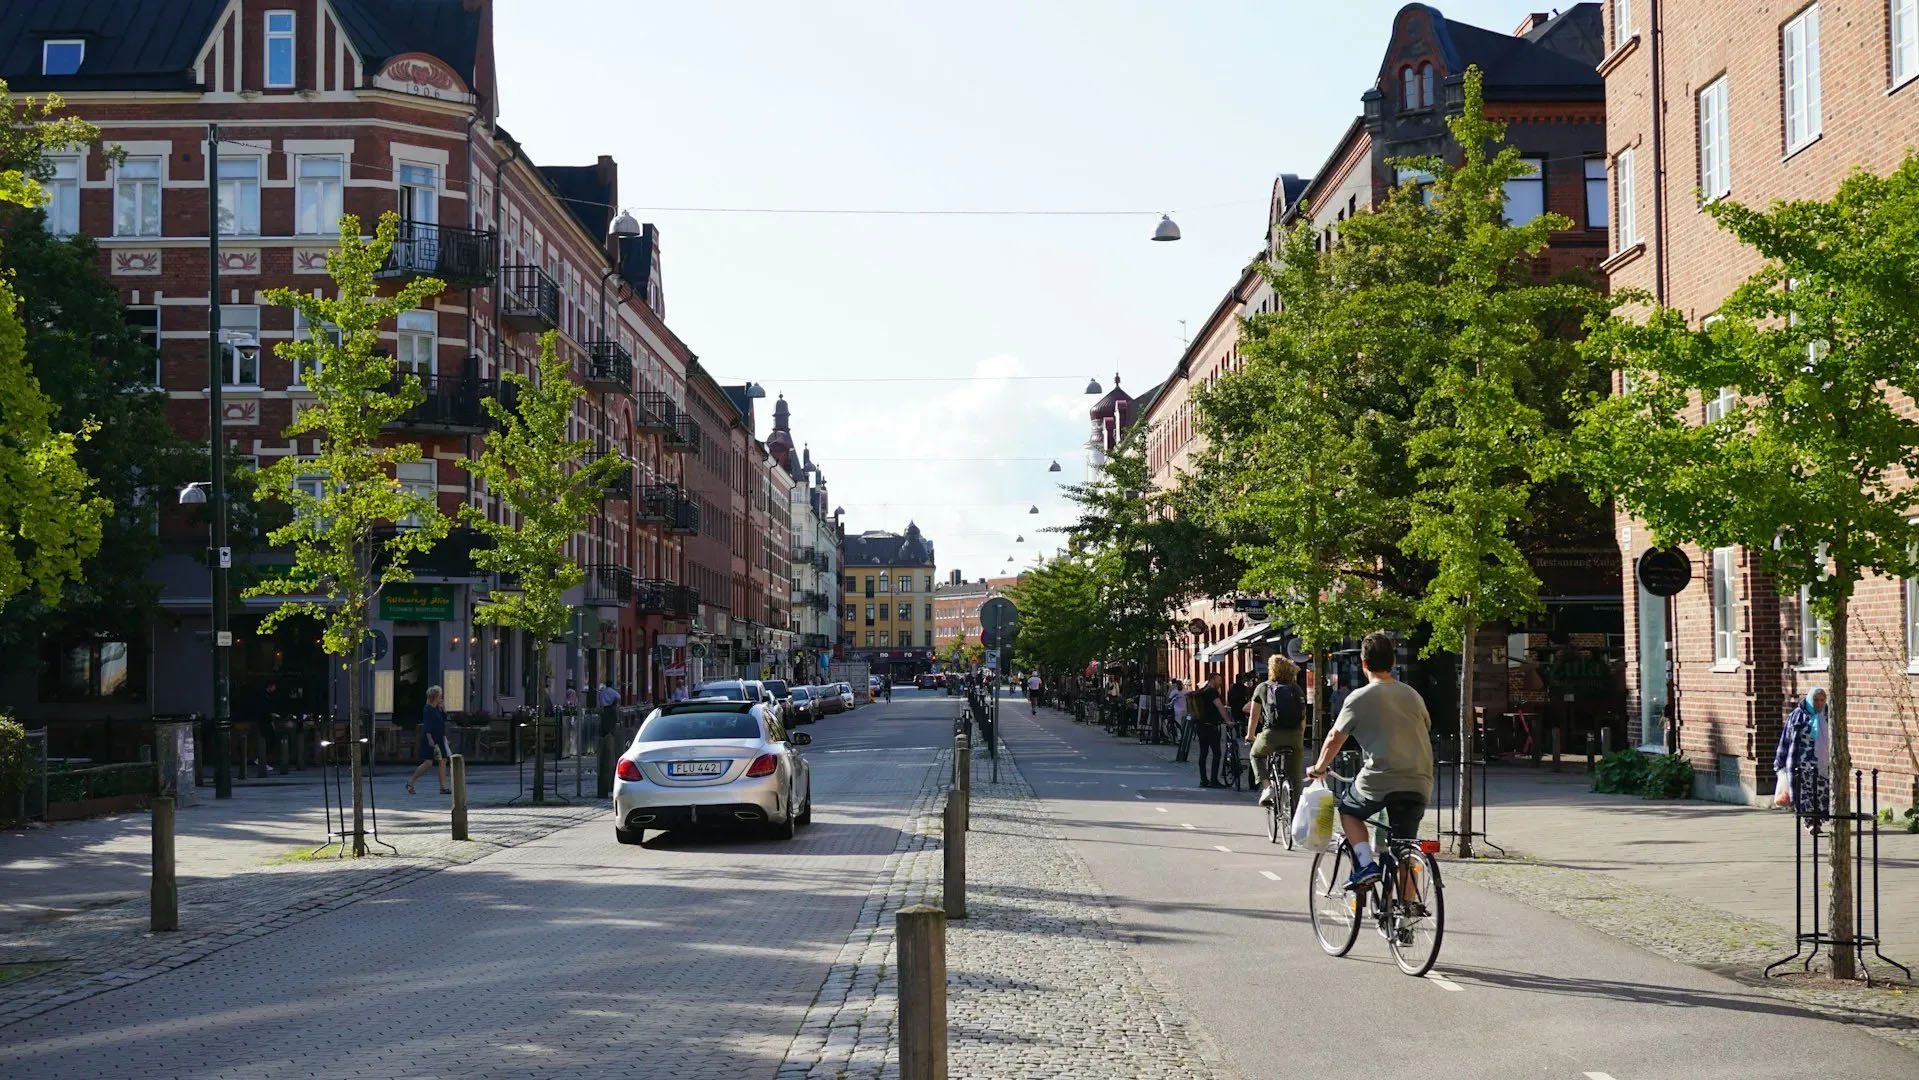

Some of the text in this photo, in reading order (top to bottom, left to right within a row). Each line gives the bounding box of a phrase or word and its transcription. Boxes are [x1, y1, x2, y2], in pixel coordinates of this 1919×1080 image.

[406, 83, 441, 97] 1906
[676, 763, 716, 772] FLU 442
